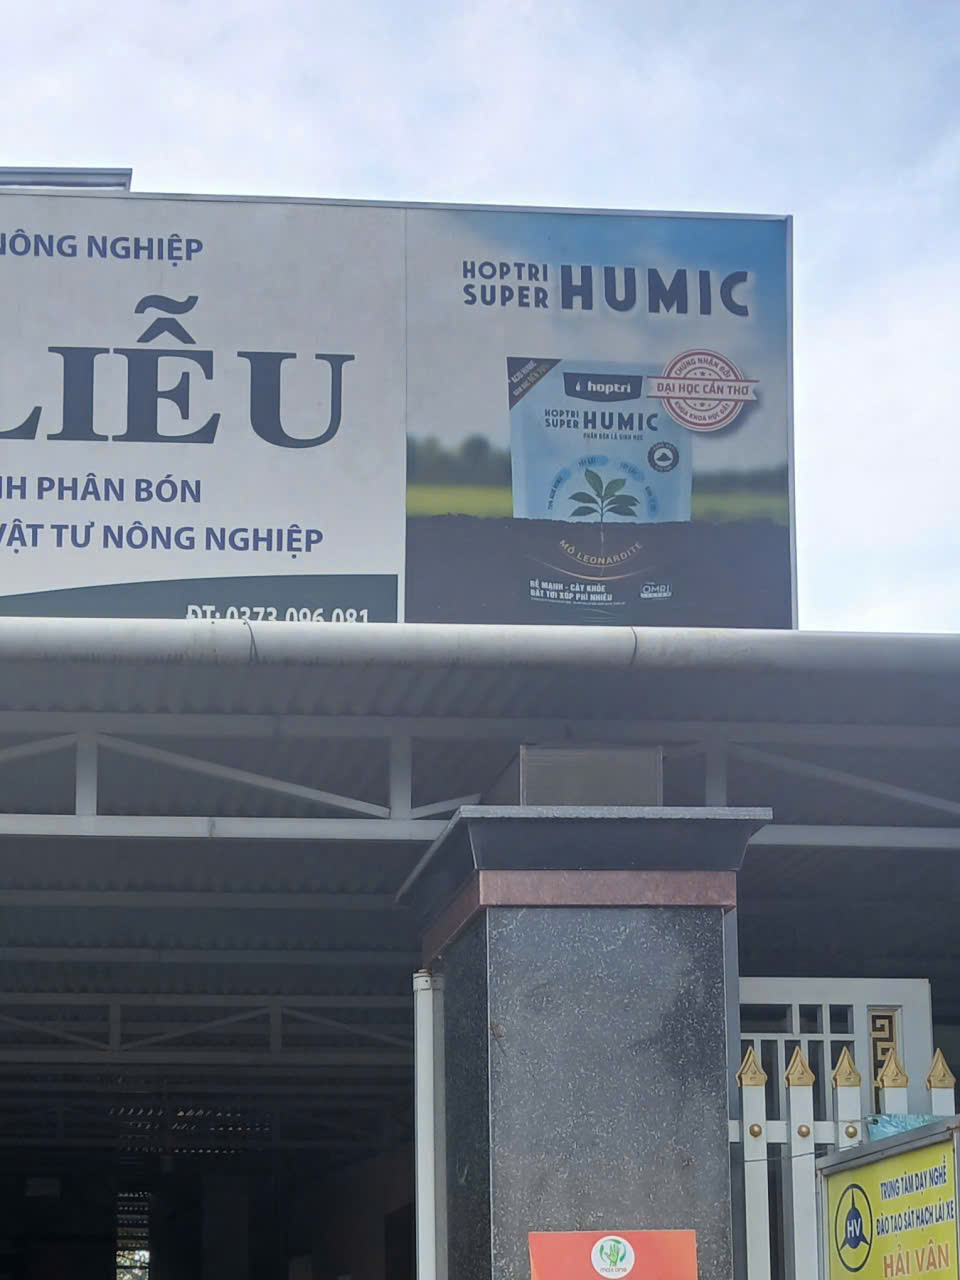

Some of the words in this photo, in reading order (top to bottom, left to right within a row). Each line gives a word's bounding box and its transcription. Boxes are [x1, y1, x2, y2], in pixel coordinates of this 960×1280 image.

[86, 232, 204, 268] NGHIỆP
[463, 261, 548, 282] HOPTRI
[463, 284, 548, 309] SUPER
[561, 264, 749, 317] HUMIC
[587, 379, 631, 396] hoptri
[657, 382, 675, 395] ĐẠI
[678, 382, 700, 396] HỌC
[727, 384, 749, 396] THƠ
[544, 408, 579, 419] HOPTRI
[544, 419, 579, 430] SUPER
[583, 410, 658, 432] HUMIC
[37, 470, 126, 503] PHÂN
[134, 470, 202, 504] BÓN
[51, 520, 95, 550] TƯ
[102, 518, 195, 552] NÔNG
[204, 524, 324, 560] NGHIỆP
[576, 541, 643, 565] LEONARDITE
[880, 1181, 900, 1200] TRUNG
[900, 1171, 914, 1195] TÂM
[915, 1171, 928, 1195] DẠY
[846, 1218, 861, 1237] HV
[876, 1213, 889, 1236] ĐÀO
[890, 1212, 902, 1238] TẠO
[904, 1206, 915, 1230] SÁT
[916, 1205, 933, 1231] HẠCH
[935, 1198, 945, 1222] LÁI
[946, 1200, 954, 1220] XE
[883, 1243, 910, 1278] HẢI
[915, 1239, 949, 1273] VÂN
